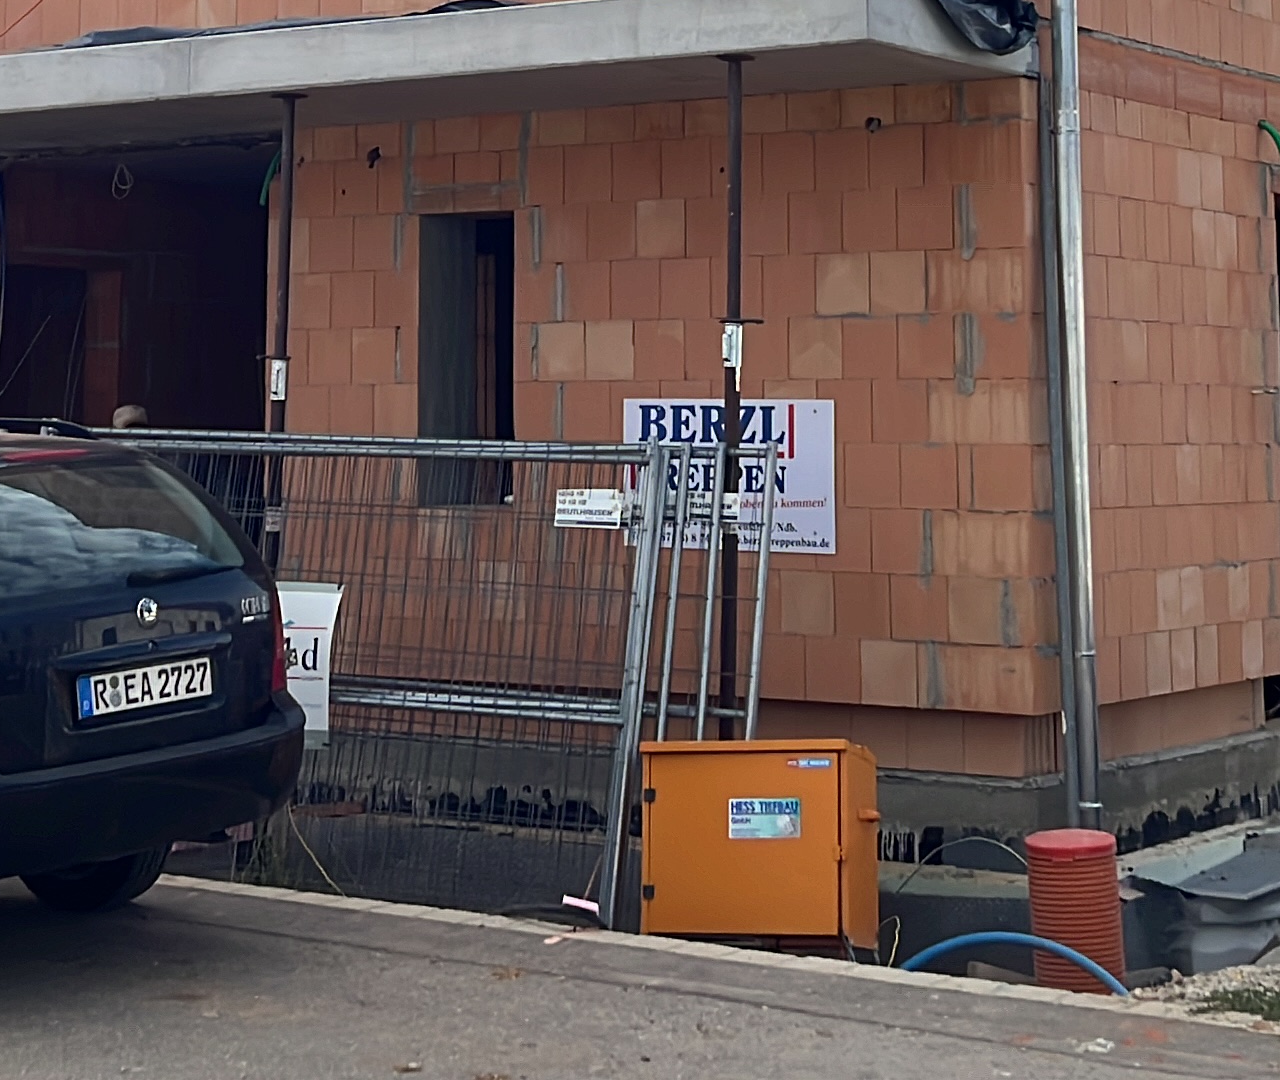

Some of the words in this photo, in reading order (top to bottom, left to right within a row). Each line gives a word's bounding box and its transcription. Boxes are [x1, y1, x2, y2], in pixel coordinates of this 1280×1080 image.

[94, 679, 109, 710] R
[123, 671, 154, 705] EA
[158, 662, 208, 699] 2727
[731, 801, 756, 815] HESS
